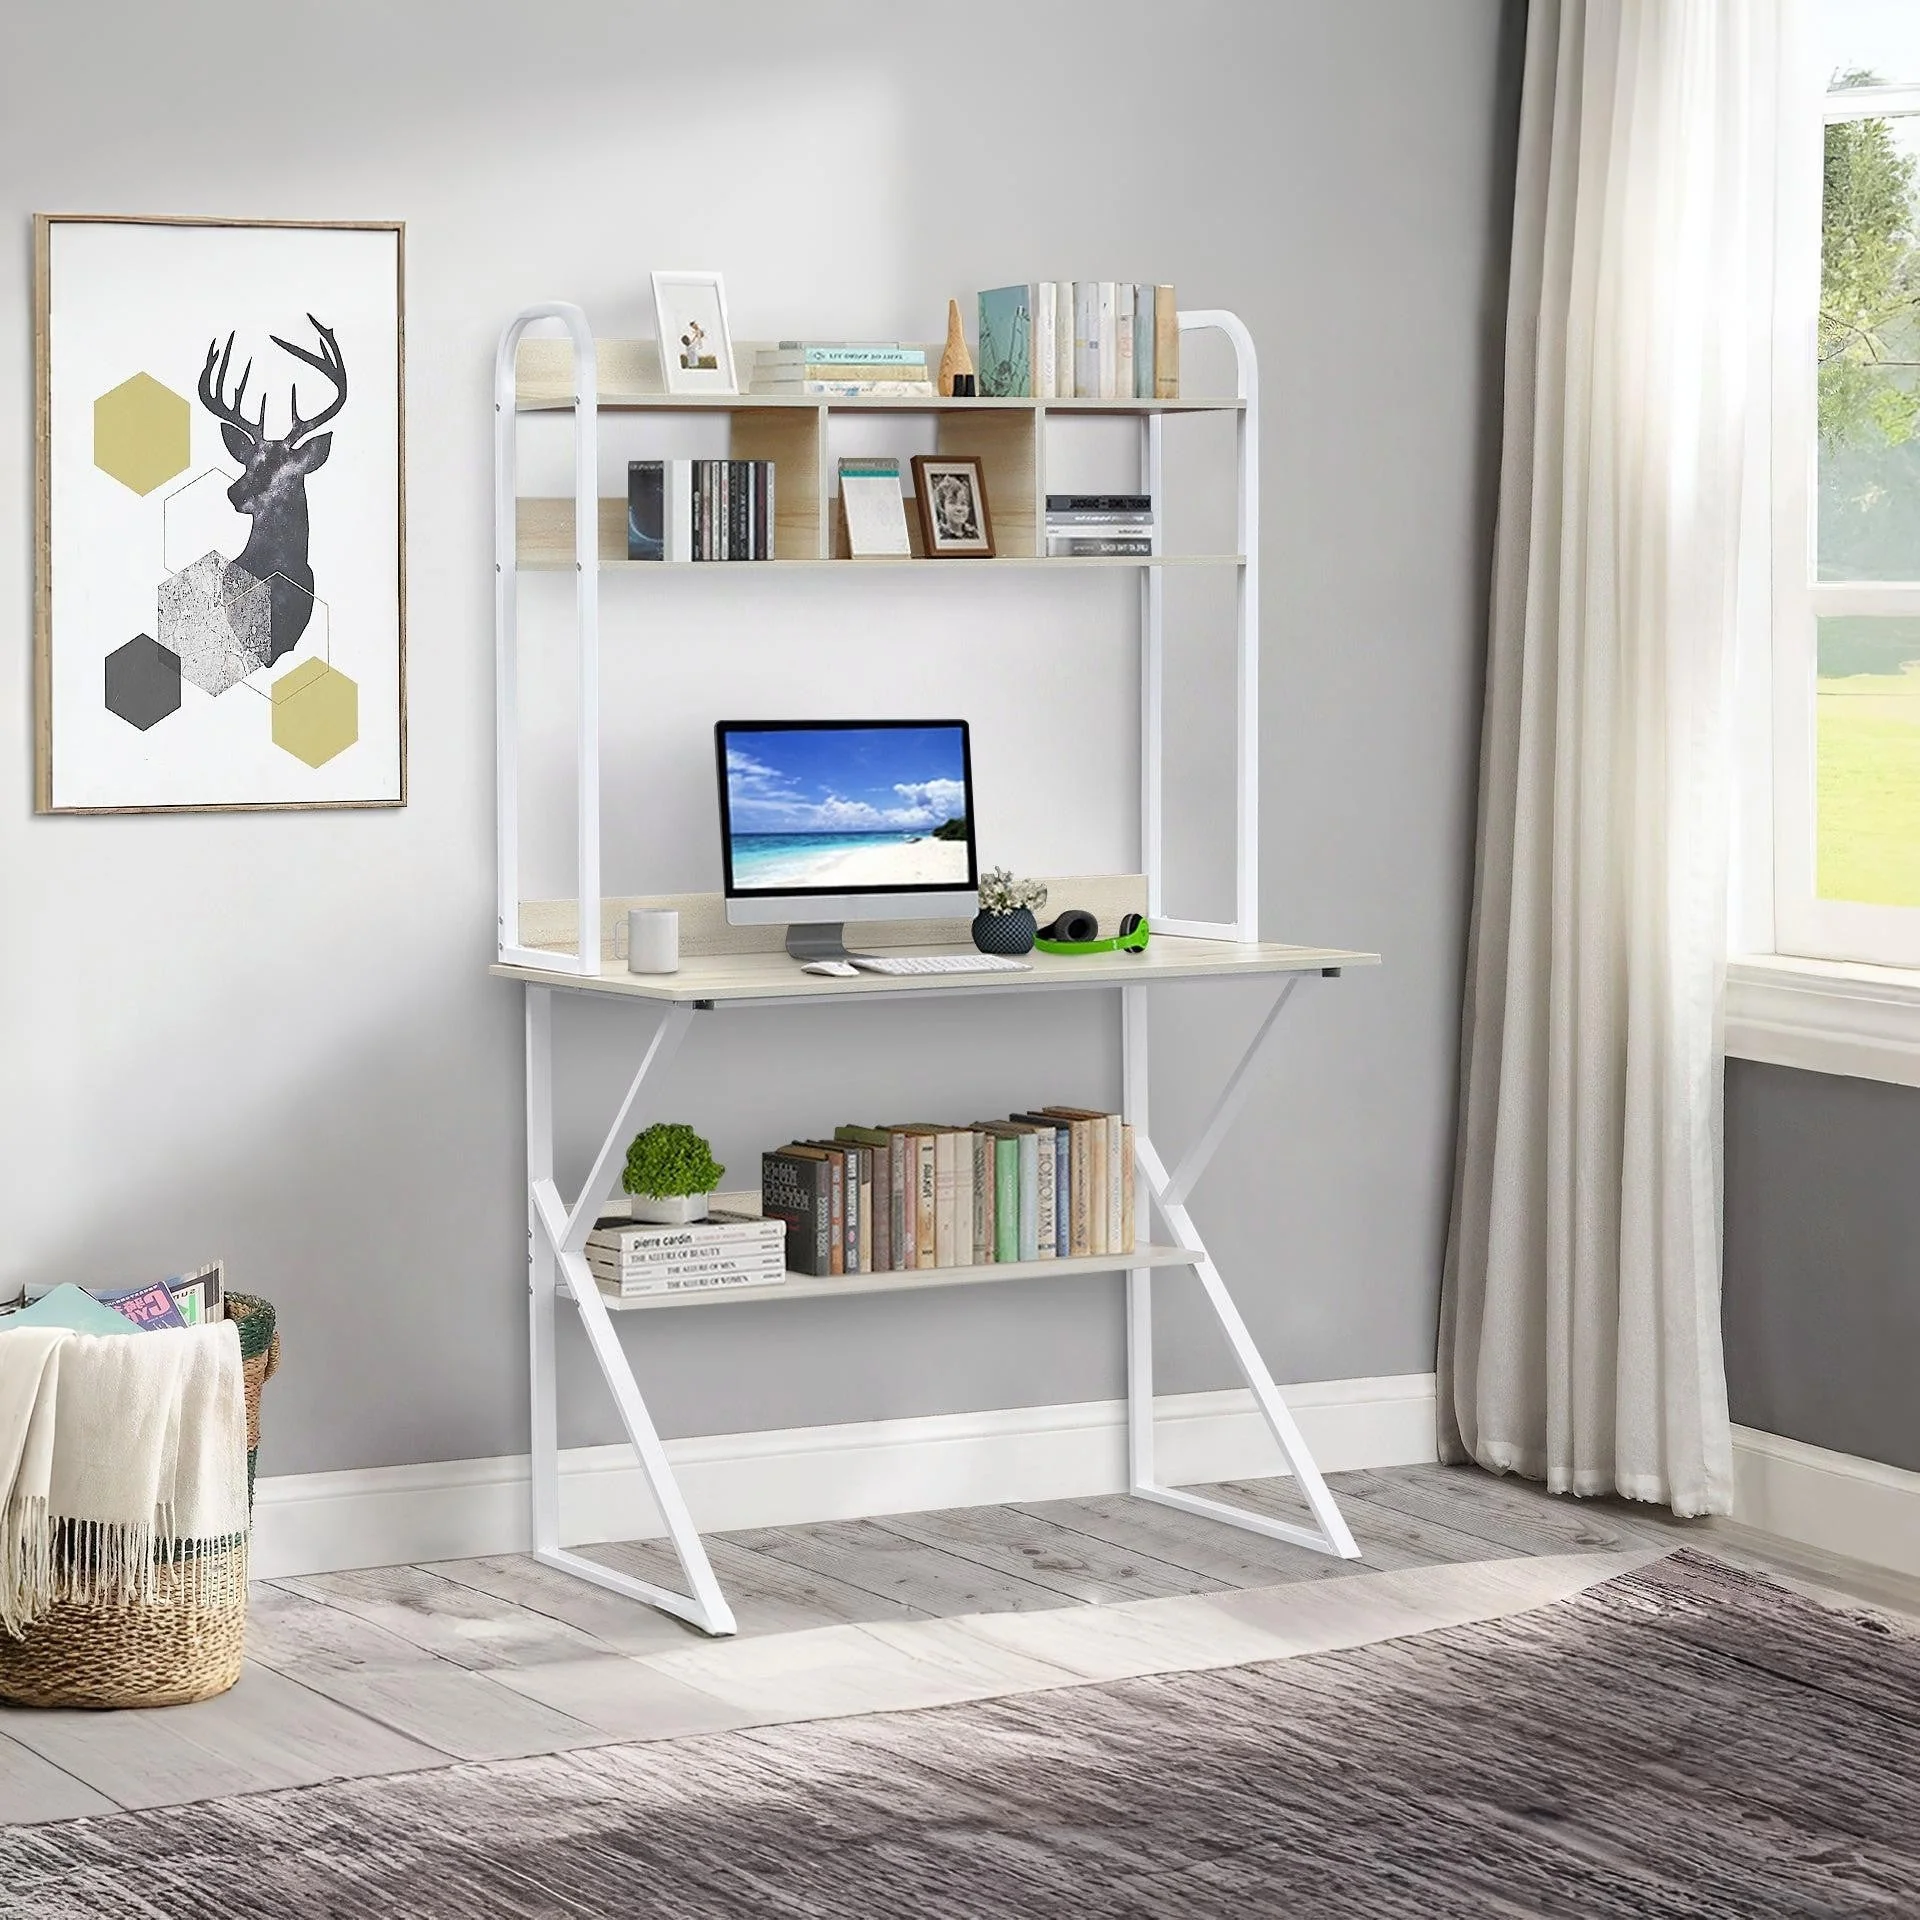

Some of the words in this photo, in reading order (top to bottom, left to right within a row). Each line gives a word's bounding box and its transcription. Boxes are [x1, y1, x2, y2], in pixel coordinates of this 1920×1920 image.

[634, 1236, 661, 1250] pierre
[662, 1232, 693, 1247] cardin
[631, 1253, 646, 1264] THE
[648, 1251, 676, 1261] ALLURE
[677, 1249, 688, 1259] OF
[689, 1247, 720, 1258] BEAUTY
[667, 1266, 680, 1275] THE
[720, 1261, 736, 1270] MEN
[667, 1280, 680, 1290] THE
[720, 1275, 749, 1285] WOMEN
